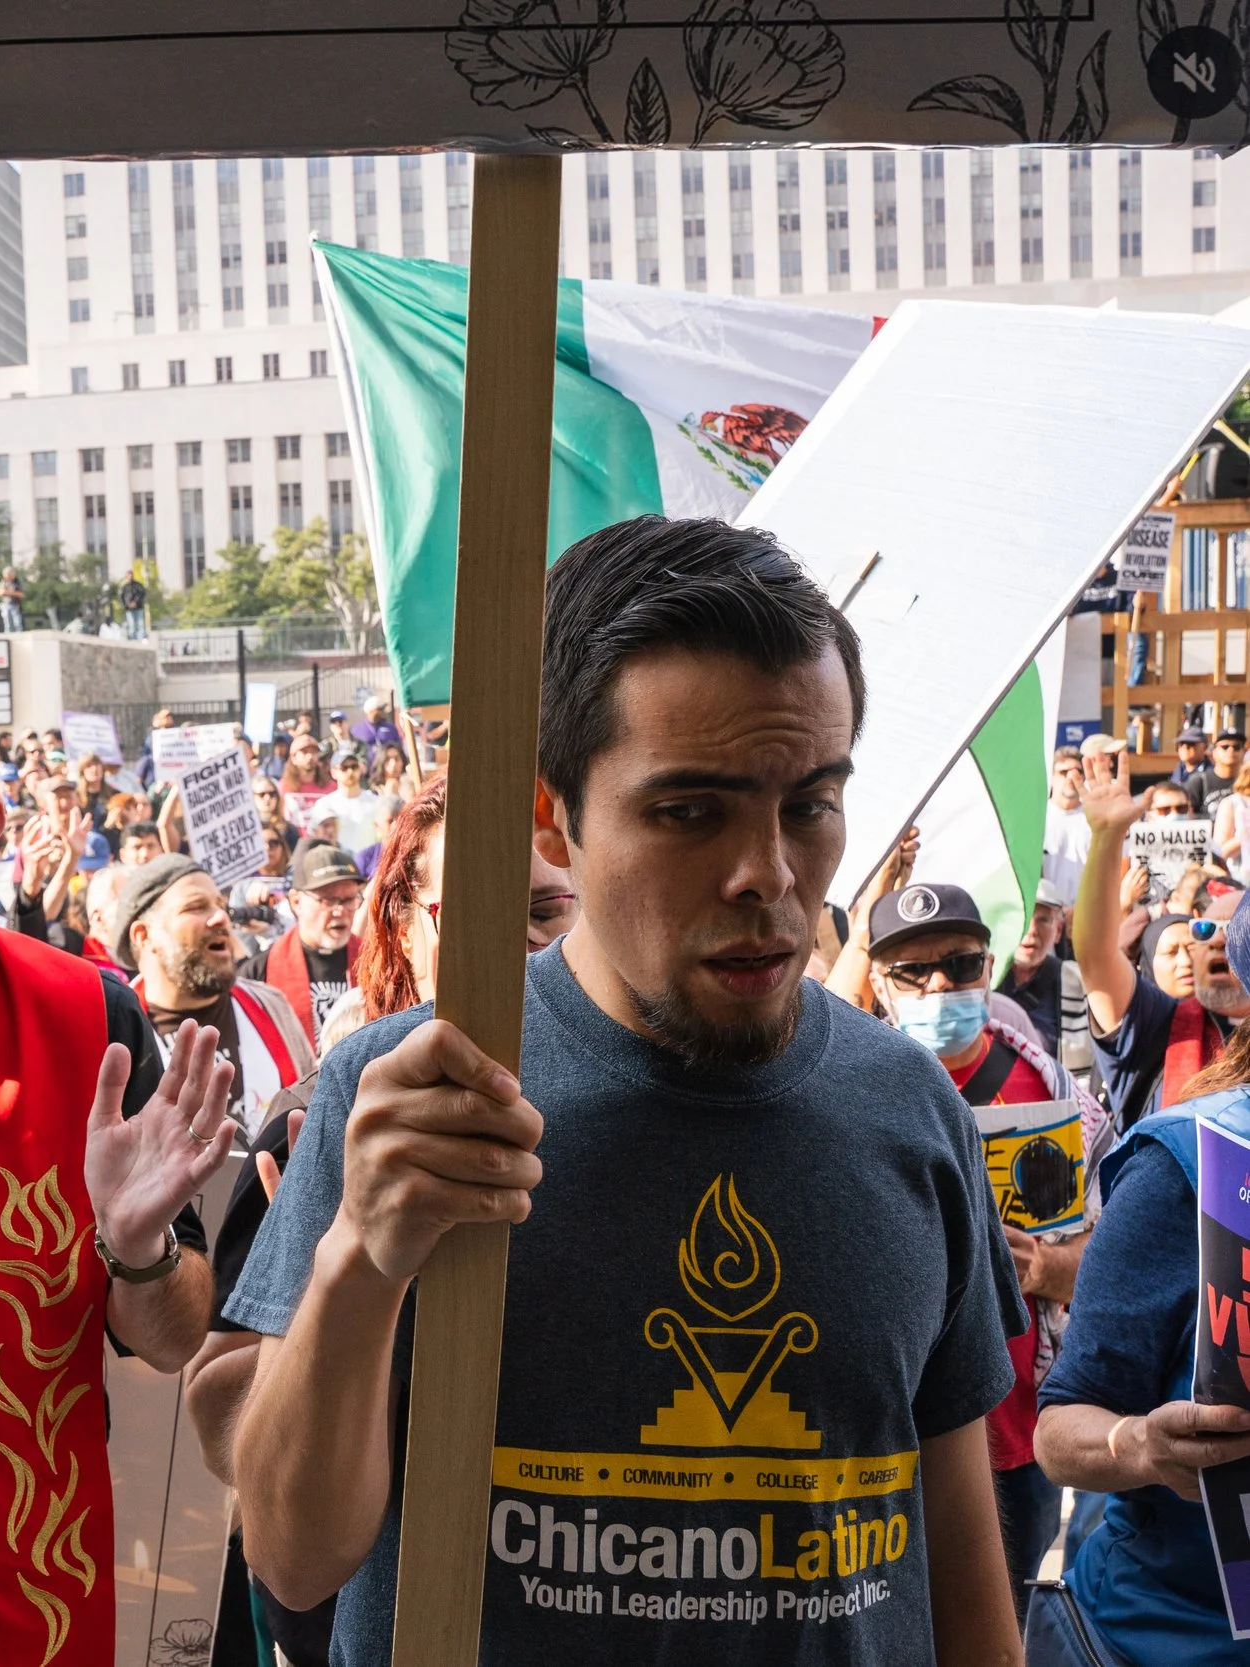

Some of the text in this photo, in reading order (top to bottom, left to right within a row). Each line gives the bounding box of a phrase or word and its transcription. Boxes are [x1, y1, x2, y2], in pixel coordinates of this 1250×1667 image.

[183, 751, 239, 790] FIGHT
[1135, 829, 1207, 845] NO WALLS
[519, 1461, 584, 1482] CULTURE
[623, 1468, 713, 1488] COMMUNITY
[756, 1471, 819, 1490] COLLEGE
[491, 1500, 909, 1581] ChicanoLatino
[519, 1575, 891, 1625] Youth Leadership Project Inc.
